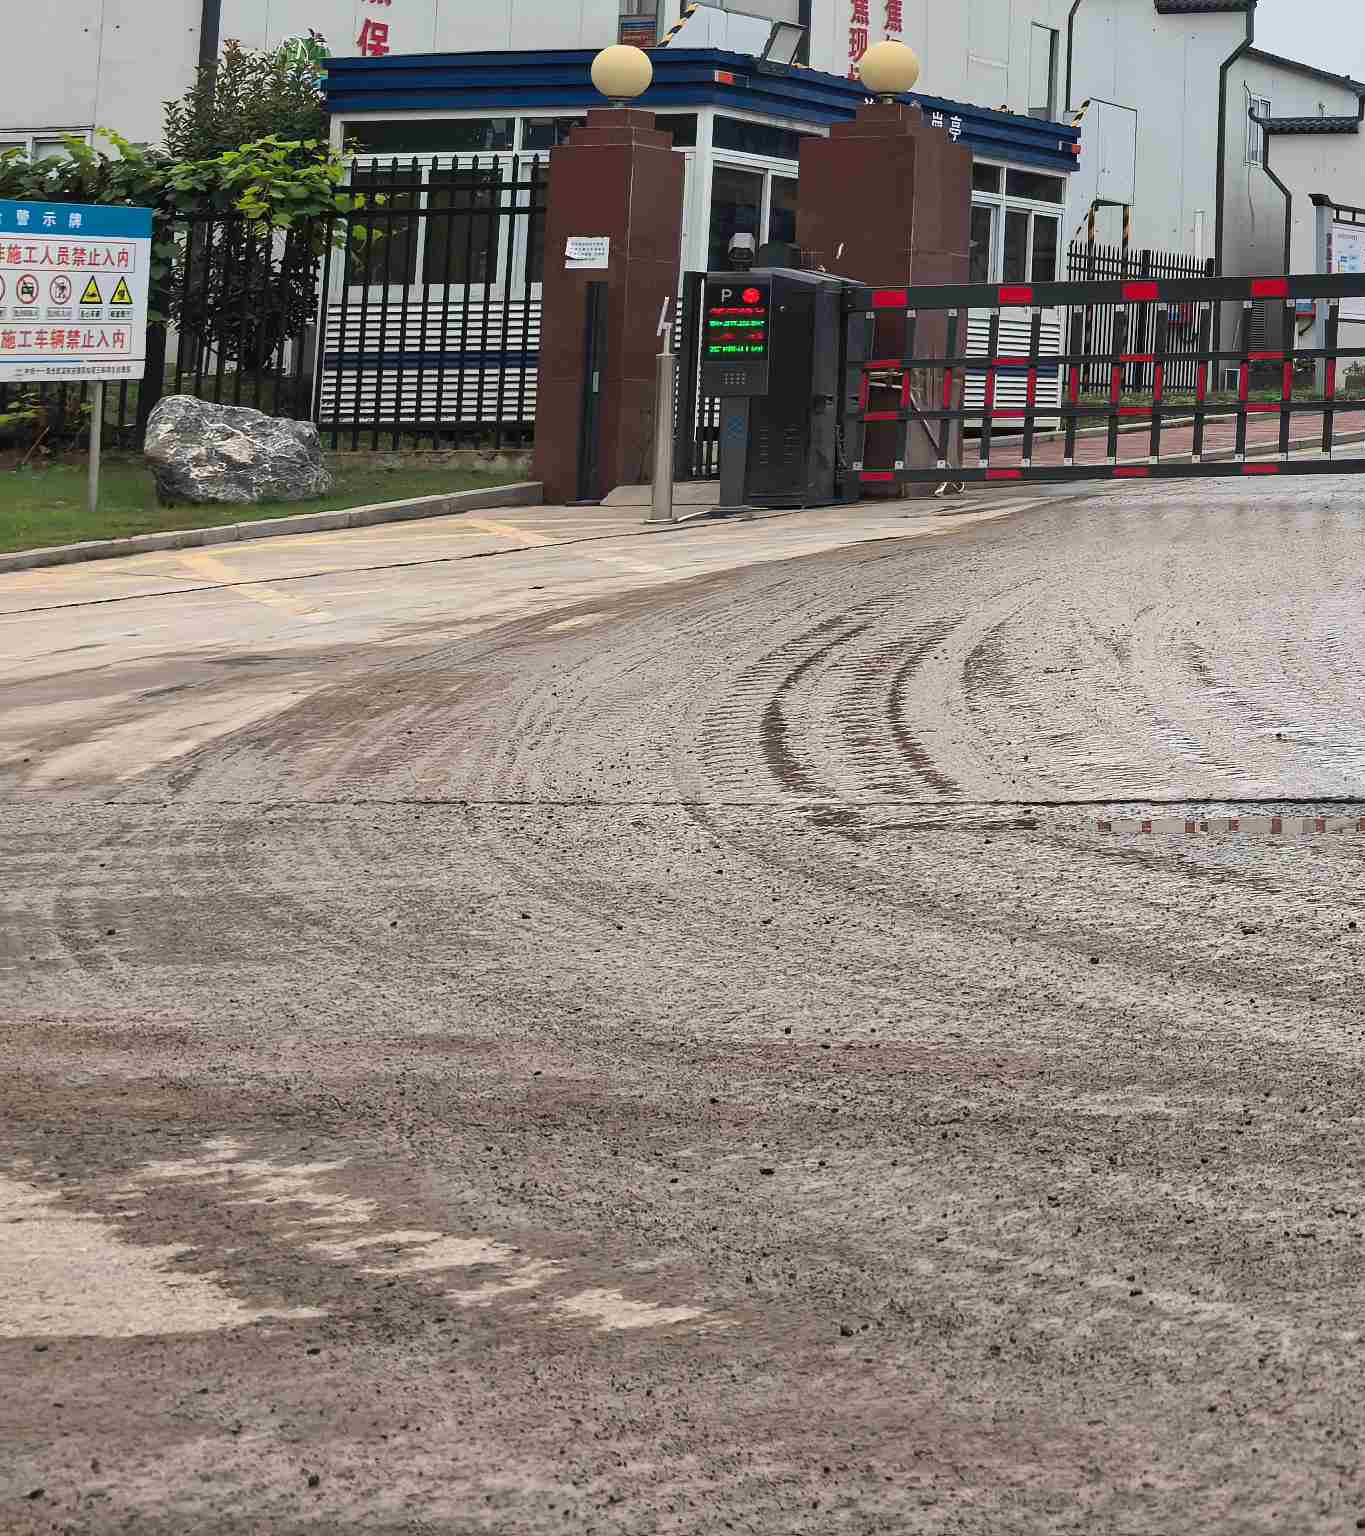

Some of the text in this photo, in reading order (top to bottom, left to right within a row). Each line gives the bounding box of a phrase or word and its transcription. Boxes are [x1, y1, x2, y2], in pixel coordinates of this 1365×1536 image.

[0, 209, 82, 229] 警示牌
[721, 288, 732, 303] P
